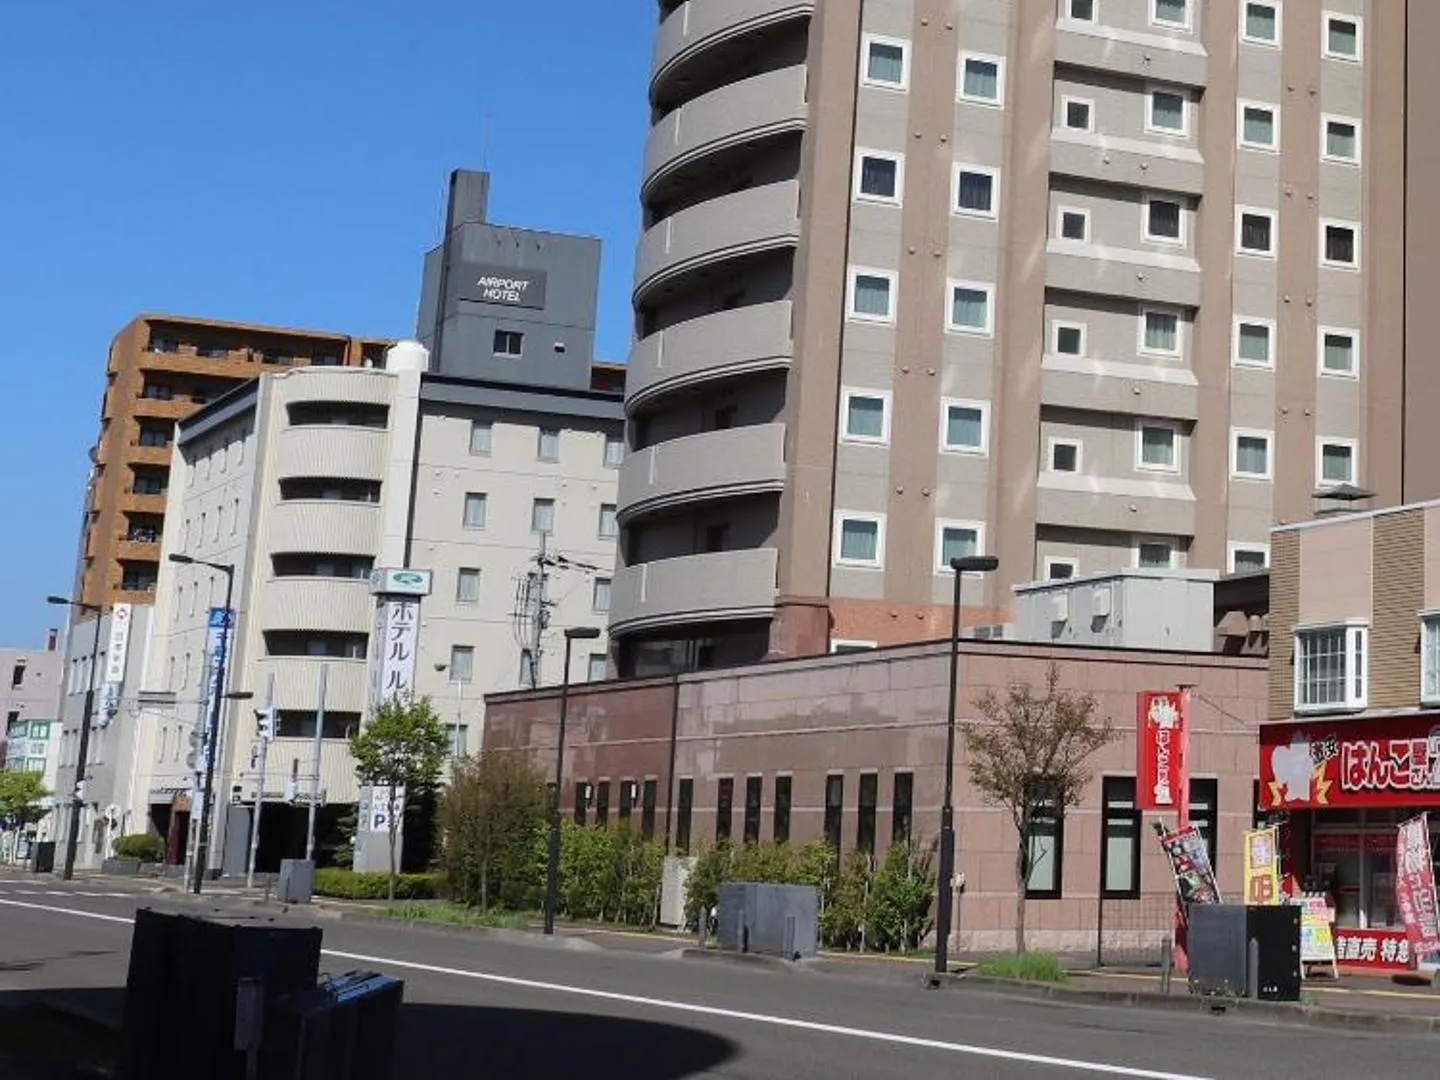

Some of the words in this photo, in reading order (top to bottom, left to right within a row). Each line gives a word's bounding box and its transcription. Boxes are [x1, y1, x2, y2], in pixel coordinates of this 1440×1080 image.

[476, 276, 530, 292] AIRPORT
[483, 287, 521, 302] HOTEL
[389, 602, 413, 661] ホテル
[374, 814, 386, 828] P
